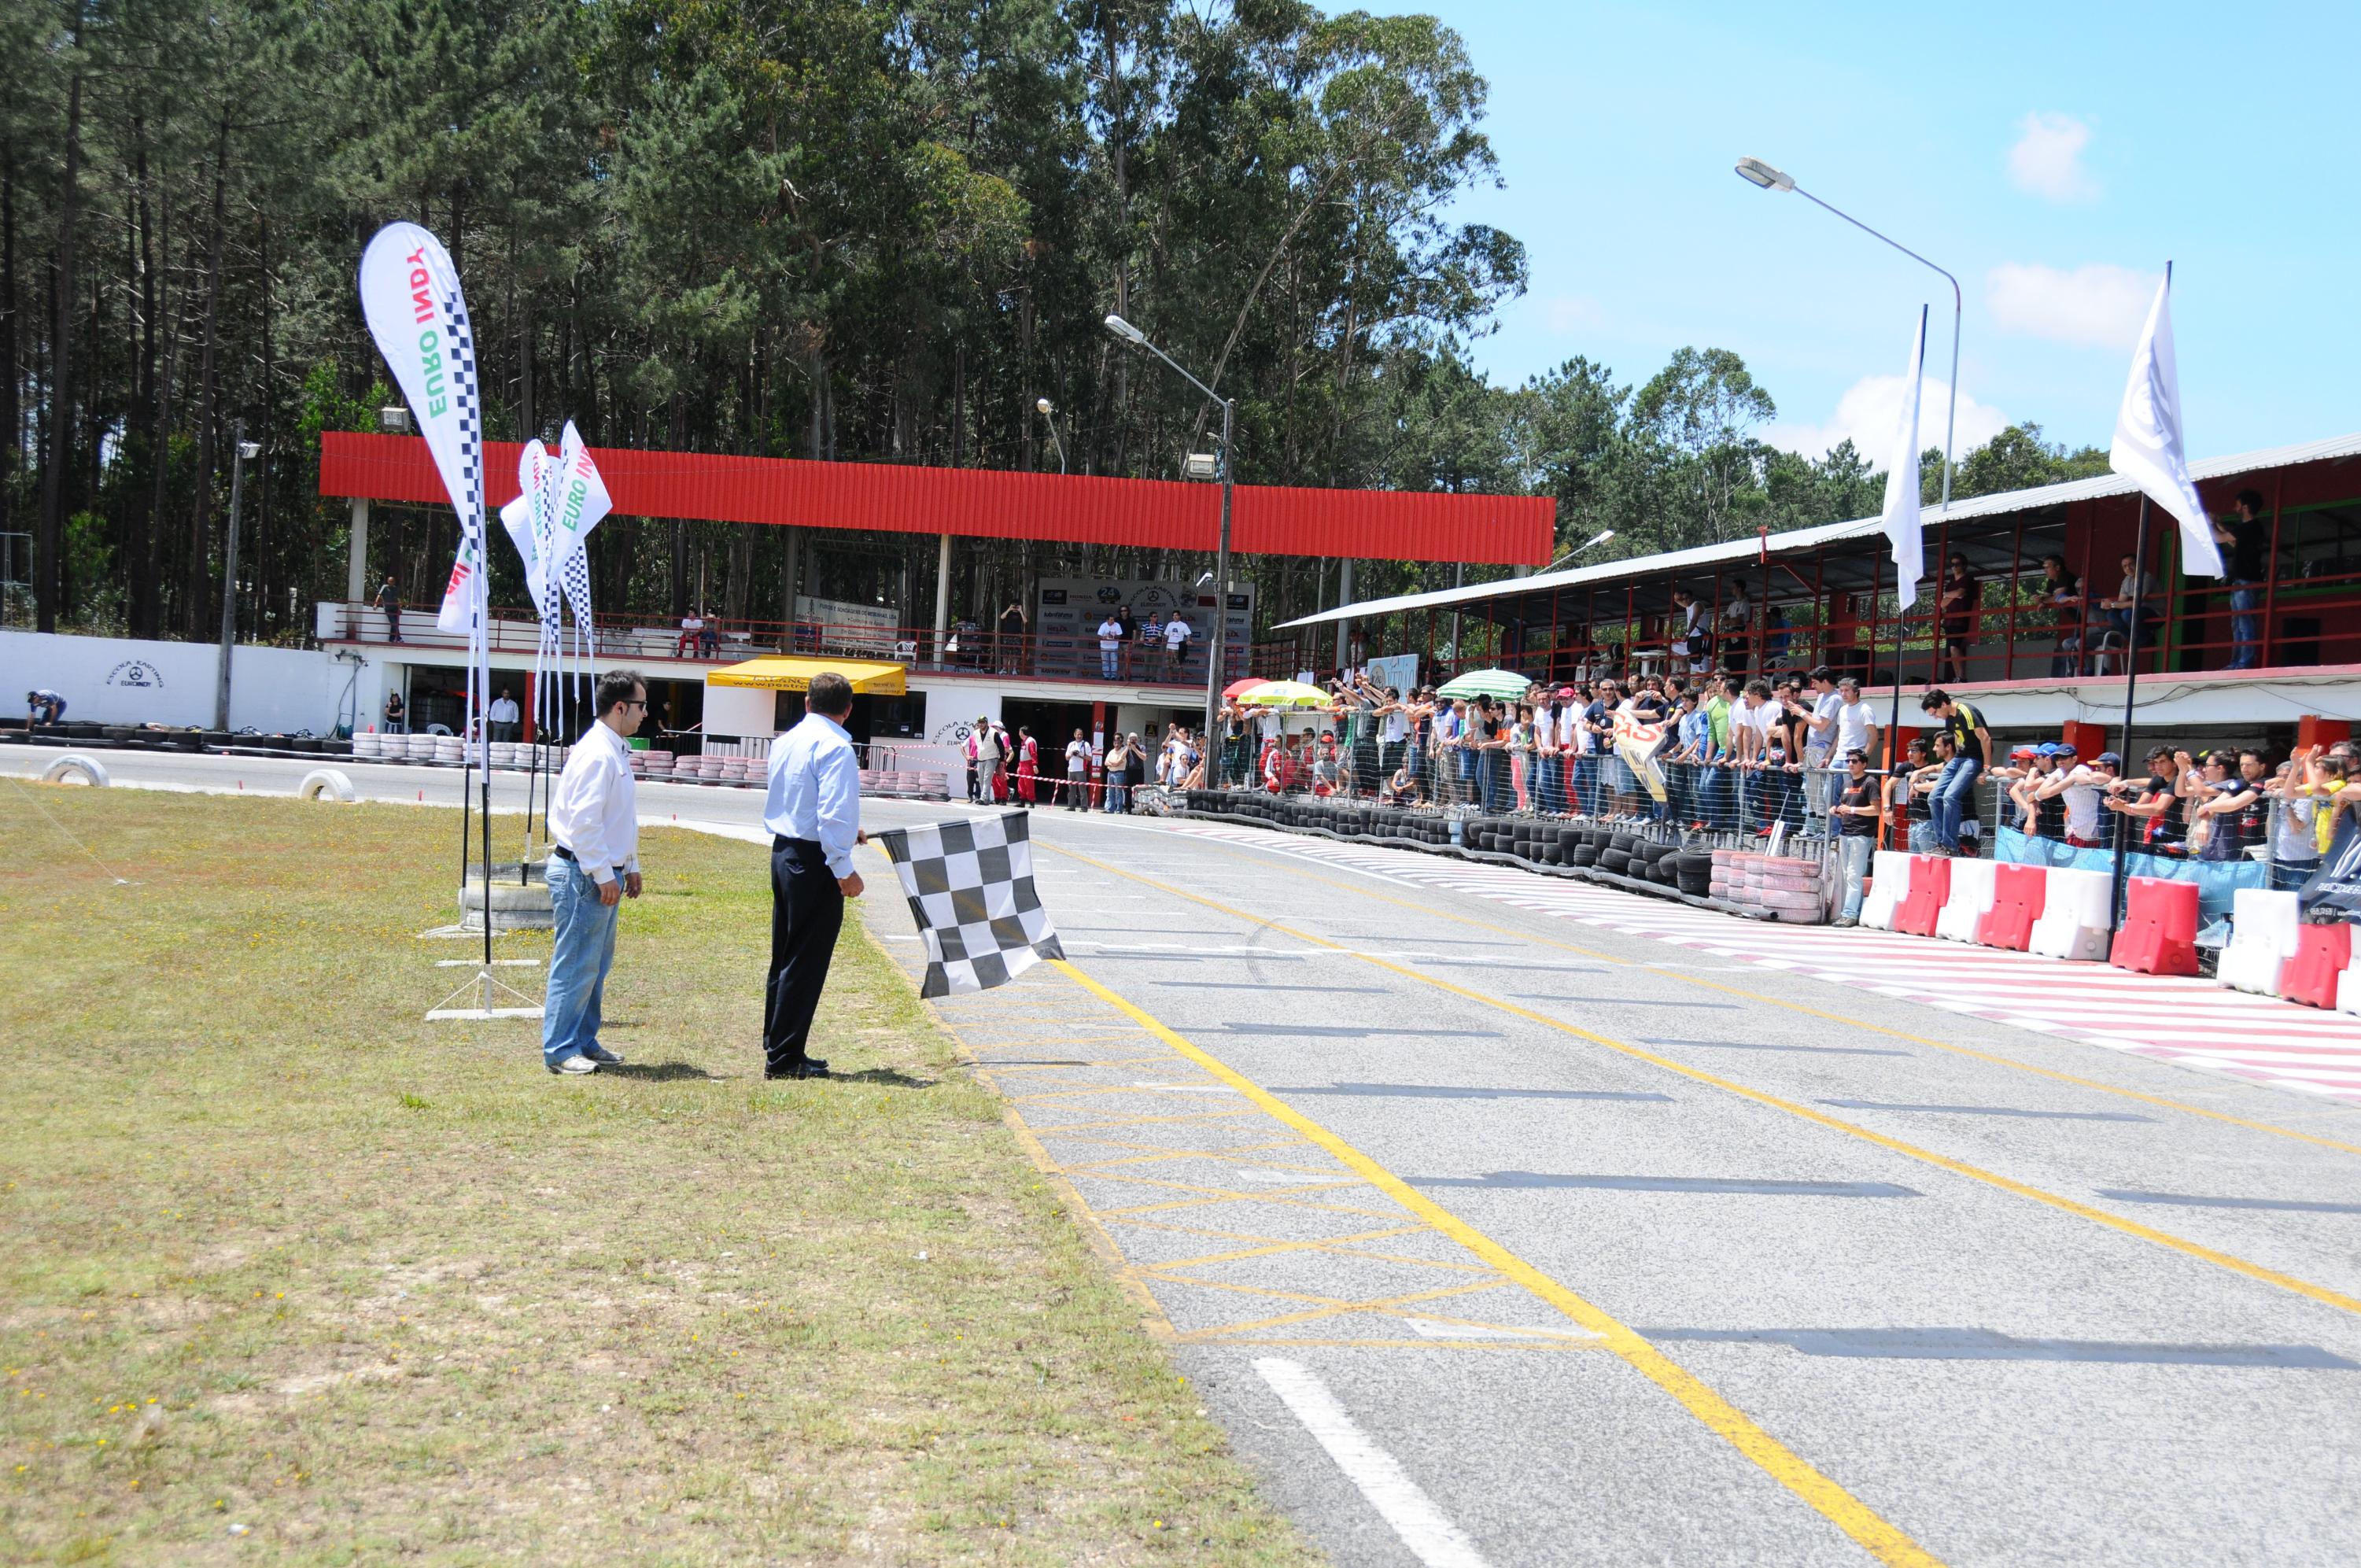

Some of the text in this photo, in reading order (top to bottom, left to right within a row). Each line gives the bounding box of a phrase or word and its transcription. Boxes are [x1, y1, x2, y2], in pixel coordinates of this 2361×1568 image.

[562, 478, 588, 532] EURO
[106, 659, 164, 688] ESCOLA KARTING
[932, 721, 959, 745] ESCOLA
